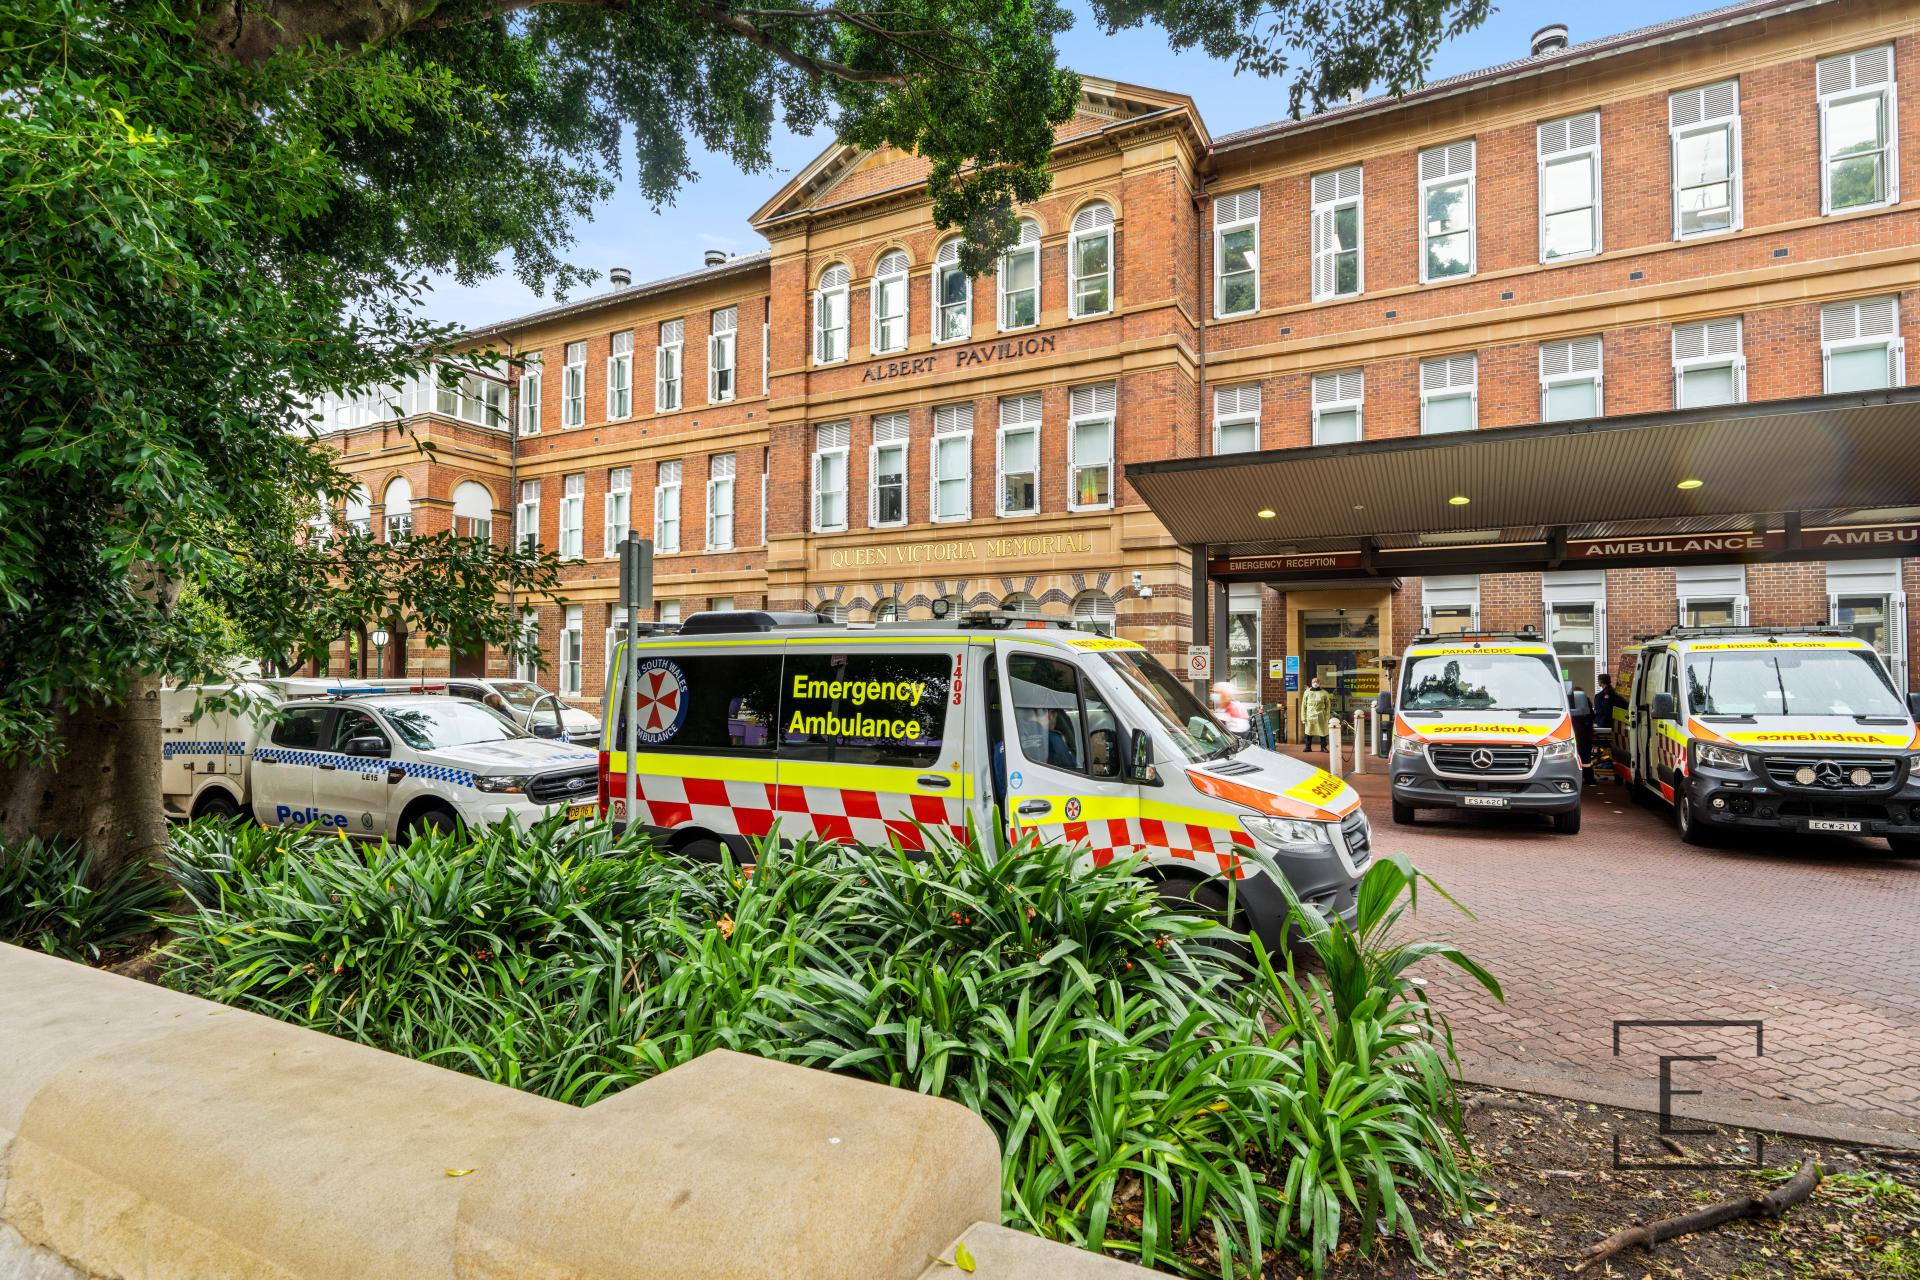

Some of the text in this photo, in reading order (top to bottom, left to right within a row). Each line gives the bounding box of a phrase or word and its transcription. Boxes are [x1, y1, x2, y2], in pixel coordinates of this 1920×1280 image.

[861, 335, 1056, 383] ALBERT PAVILION
[831, 534, 1092, 568] QUEEN VICTORIA MEMORIAL
[1585, 537, 1765, 556] AMBULANCE
[1229, 557, 1336, 571] EMERGENCY RECEPTION
[641, 658, 669, 673] SOUTH
[668, 661, 688, 693] WALES
[792, 674, 926, 707] Emergency
[952, 653, 963, 706] 1403
[636, 723, 679, 743] MBULANCE
[788, 710, 921, 740] Ambulance
[361, 772, 379, 782] LE15
[276, 805, 349, 828] Police
